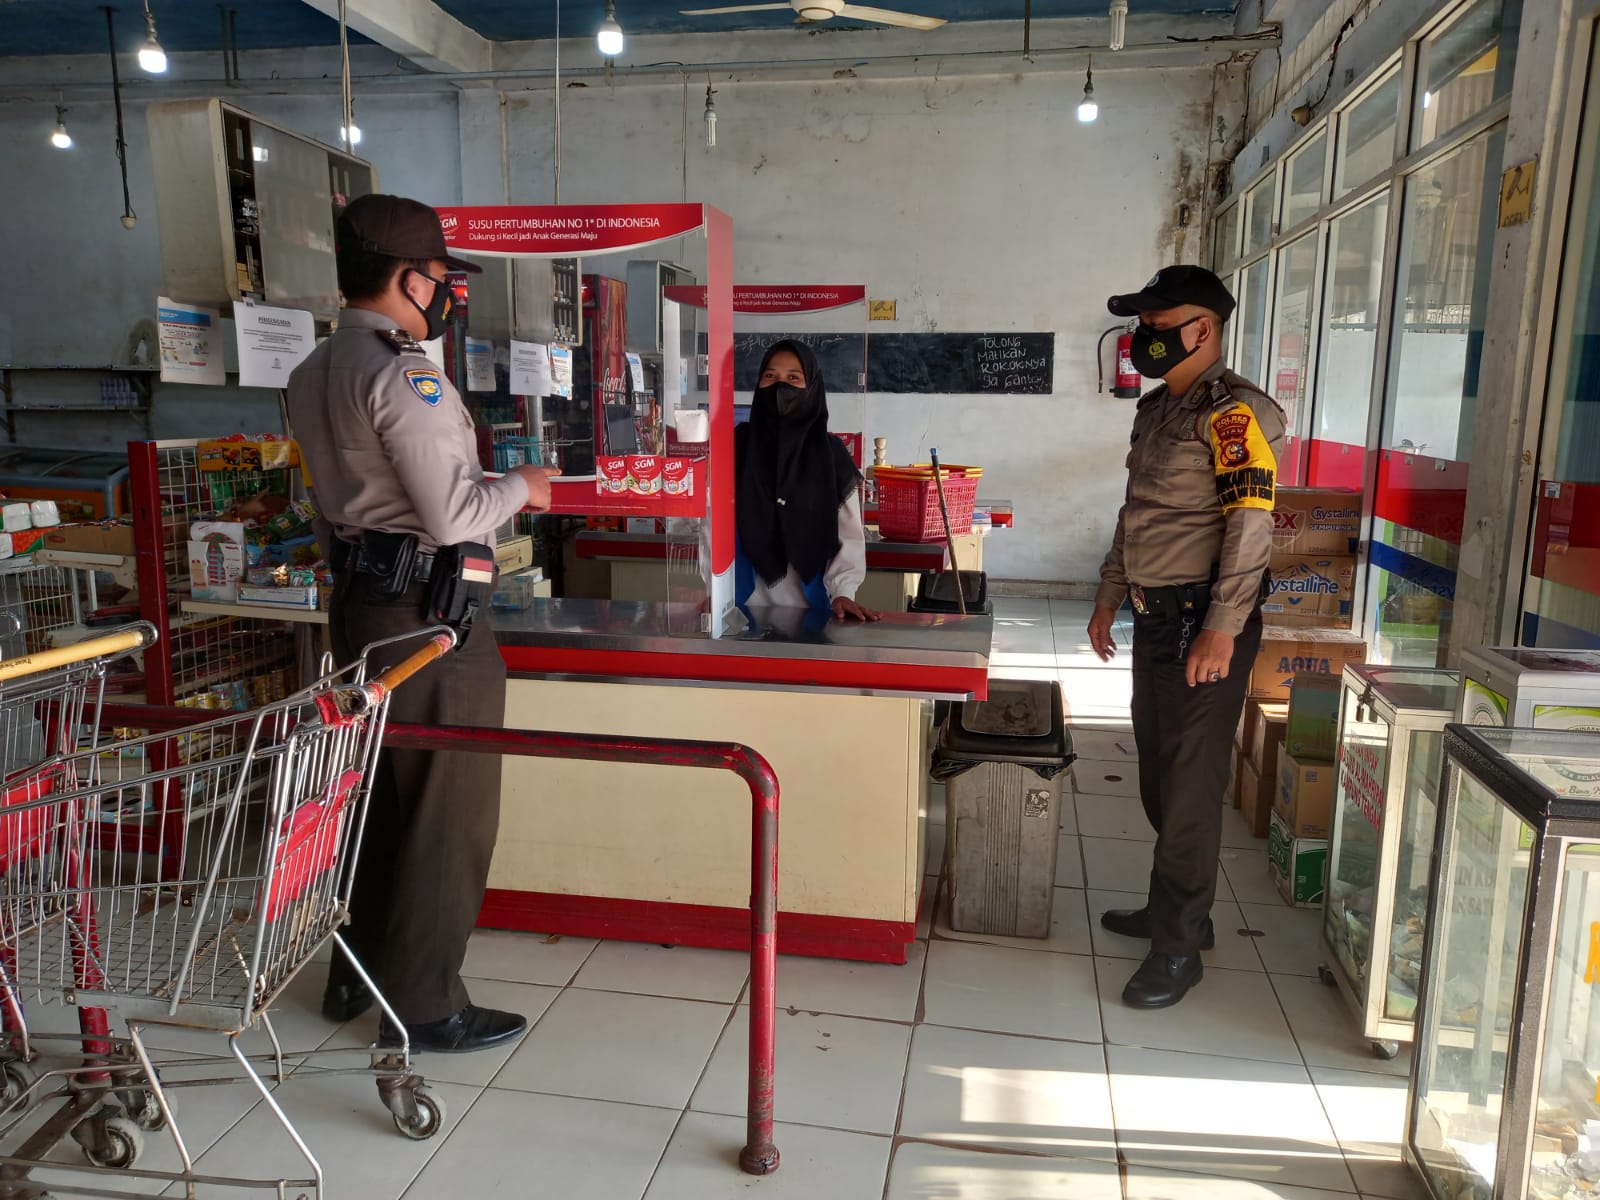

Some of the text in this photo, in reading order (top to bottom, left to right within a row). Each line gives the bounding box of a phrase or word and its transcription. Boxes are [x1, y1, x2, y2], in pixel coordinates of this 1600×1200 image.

[440, 216, 457, 228] GM
[468, 219, 493, 230] SUSU
[494, 218, 566, 229] PERTUMBUHAN
[567, 218, 583, 229] NO
[596, 218, 607, 228] DI
[608, 217, 660, 228] INDONESIA
[468, 232, 495, 242] Dukung
[496, 232, 501, 240] si
[502, 232, 518, 240] Kecil
[532, 232, 549, 240] Anak
[550, 231, 580, 240] Generasi
[581, 232, 598, 241] Maju
[607, 459, 625, 471] SGM
[634, 458, 655, 470] SGM
[664, 460, 682, 472] SGM
[1276, 655, 1331, 673] AQUA
